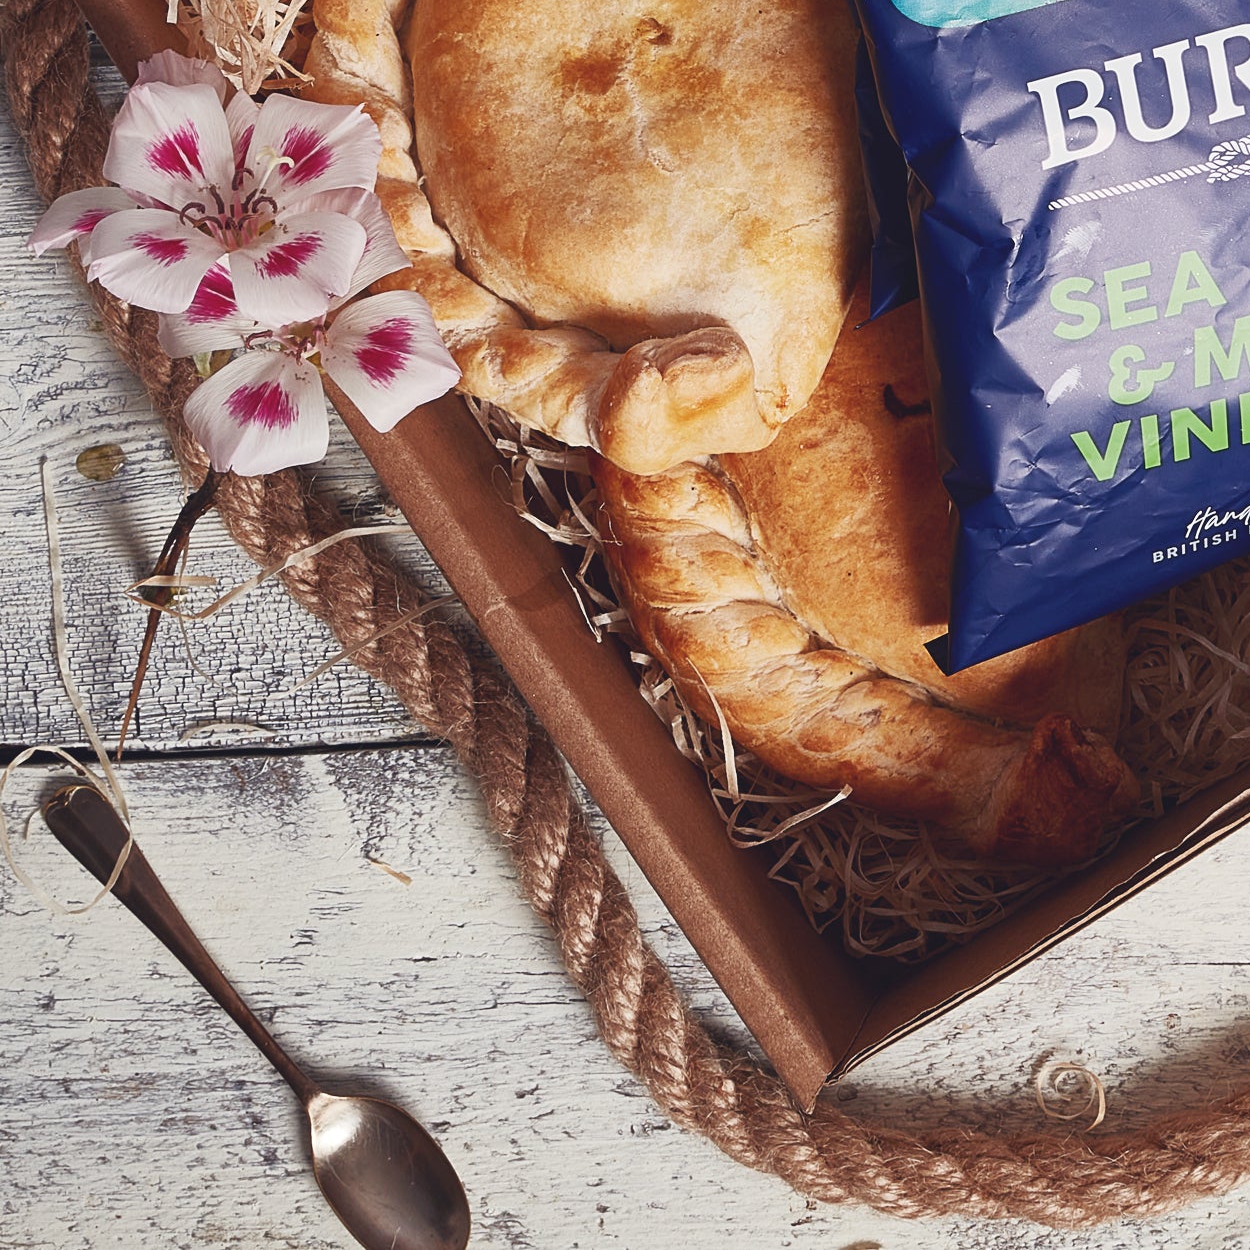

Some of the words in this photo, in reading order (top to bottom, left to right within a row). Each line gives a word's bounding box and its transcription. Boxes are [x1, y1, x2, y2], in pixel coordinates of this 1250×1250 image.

[1049, 250, 1228, 341] SEA
[1108, 345, 1175, 406] &
[1152, 529, 1238, 563] BRITISH
